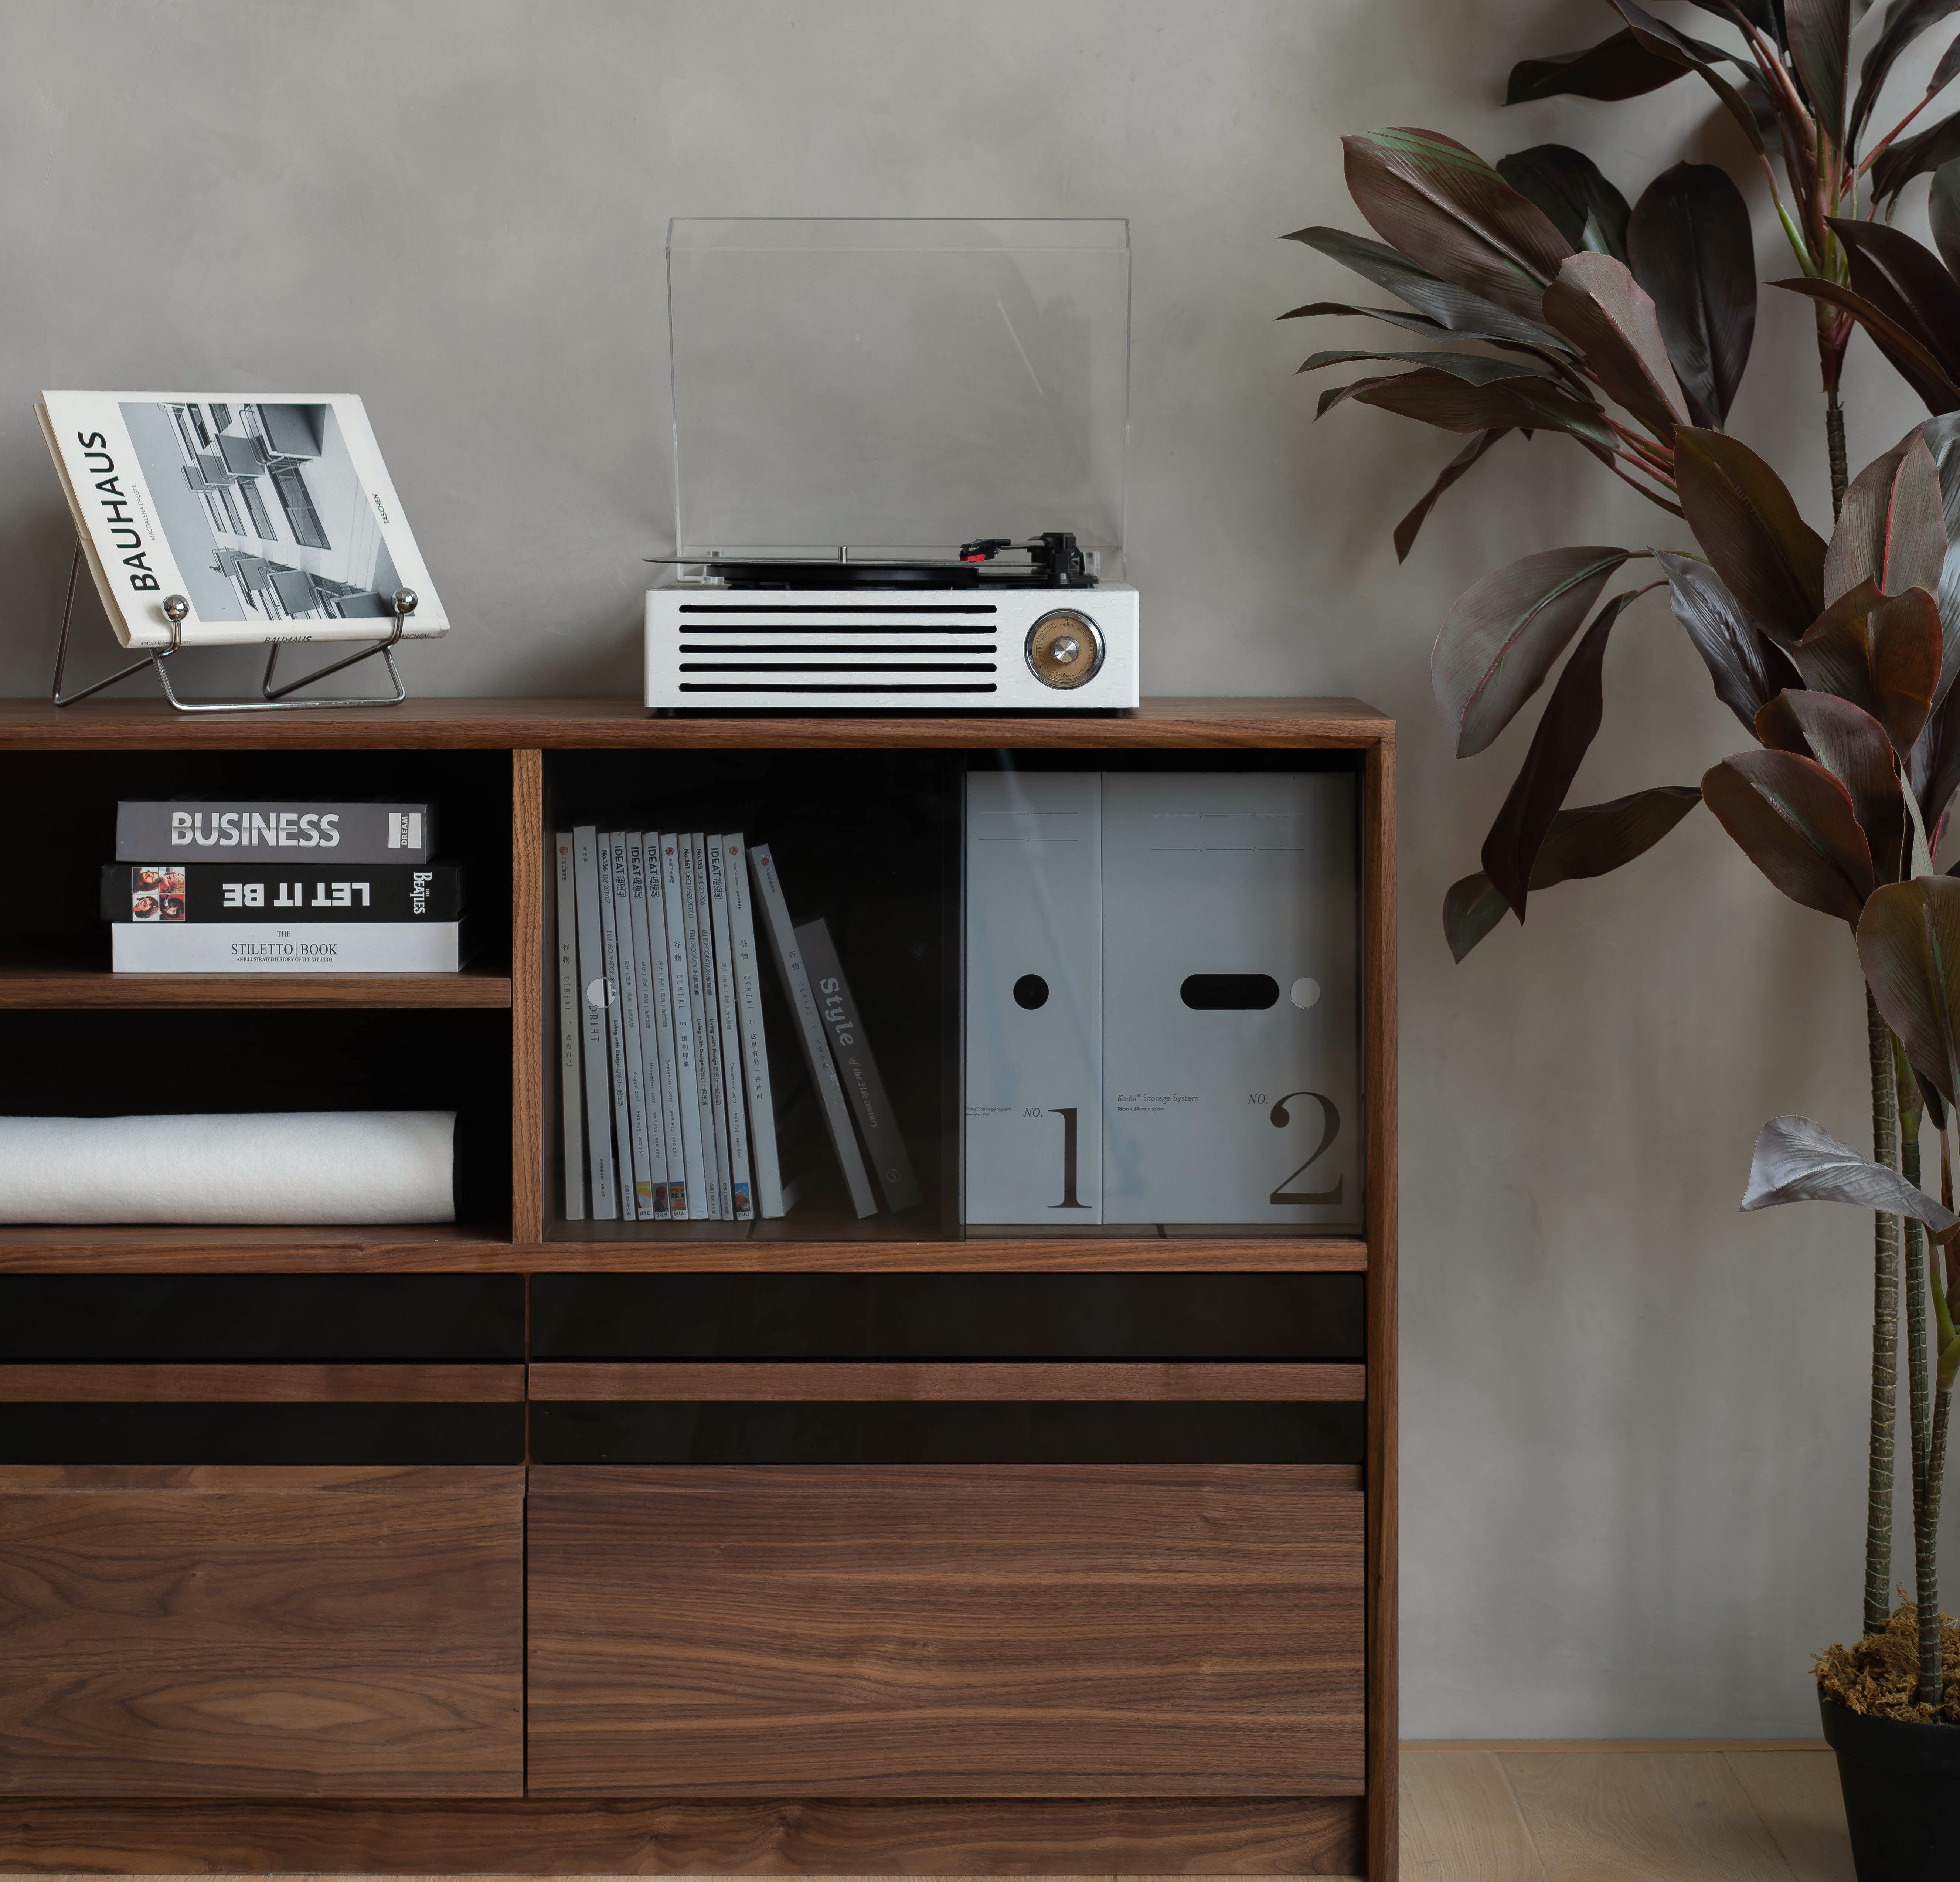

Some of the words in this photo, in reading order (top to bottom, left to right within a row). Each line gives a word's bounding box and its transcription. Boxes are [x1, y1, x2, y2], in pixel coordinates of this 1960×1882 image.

[132, 484, 143, 505] DROSTE
[78, 431, 160, 591] BAUHAUS
[372, 494, 389, 524] TASCHEN
[140, 507, 155, 540] MAGDALENA
[172, 812, 339, 847] BUSINESS
[614, 845, 625, 874] IDEAT
[631, 847, 641, 875] IDEAT
[648, 846, 658, 874] IDEAT
[711, 847, 721, 877] IDEAT
[223, 883, 264, 906] BE
[274, 883, 302, 906] IT
[312, 883, 370, 906] LET
[410, 872, 432, 914] BEATLES
[616, 876, 626, 898] 理想家
[633, 877, 643, 899] 理想家
[650, 875, 660, 898] 理想家
[713, 878, 723, 900] 理想家
[231, 944, 293, 955] STILETTO
[300, 944, 338, 955] BOOK
[562, 943, 570, 964] 谷物
[674, 941, 681, 962] 谷物
[739, 940, 748, 960] 谷物
[789, 950, 800, 971] 谷物
[677, 974, 685, 1009] CEREAL
[744, 975, 753, 1010] CEREAL
[798, 982, 813, 1016] CEREAL
[819, 977, 854, 1046] Style
[681, 1035, 689, 1068] 纽约印象
[848, 1057, 859, 1066] of
[750, 1033, 763, 1100] 这里有另一种时间
[853, 1069, 861, 1080] the
[700, 1067, 708, 1105] 与设计一起生活
[713, 1067, 721, 1105] 与设计一起生活
[1143, 1094, 1171, 1104] Storage
[1173, 1094, 1199, 1104] System
[865, 1100, 878, 1128] century
[1023, 1108, 1043, 1117] NO.
[1047, 1107, 1093, 1208] 1
[1248, 1094, 1268, 1104] NO.
[1270, 1091, 1343, 1205] 2
